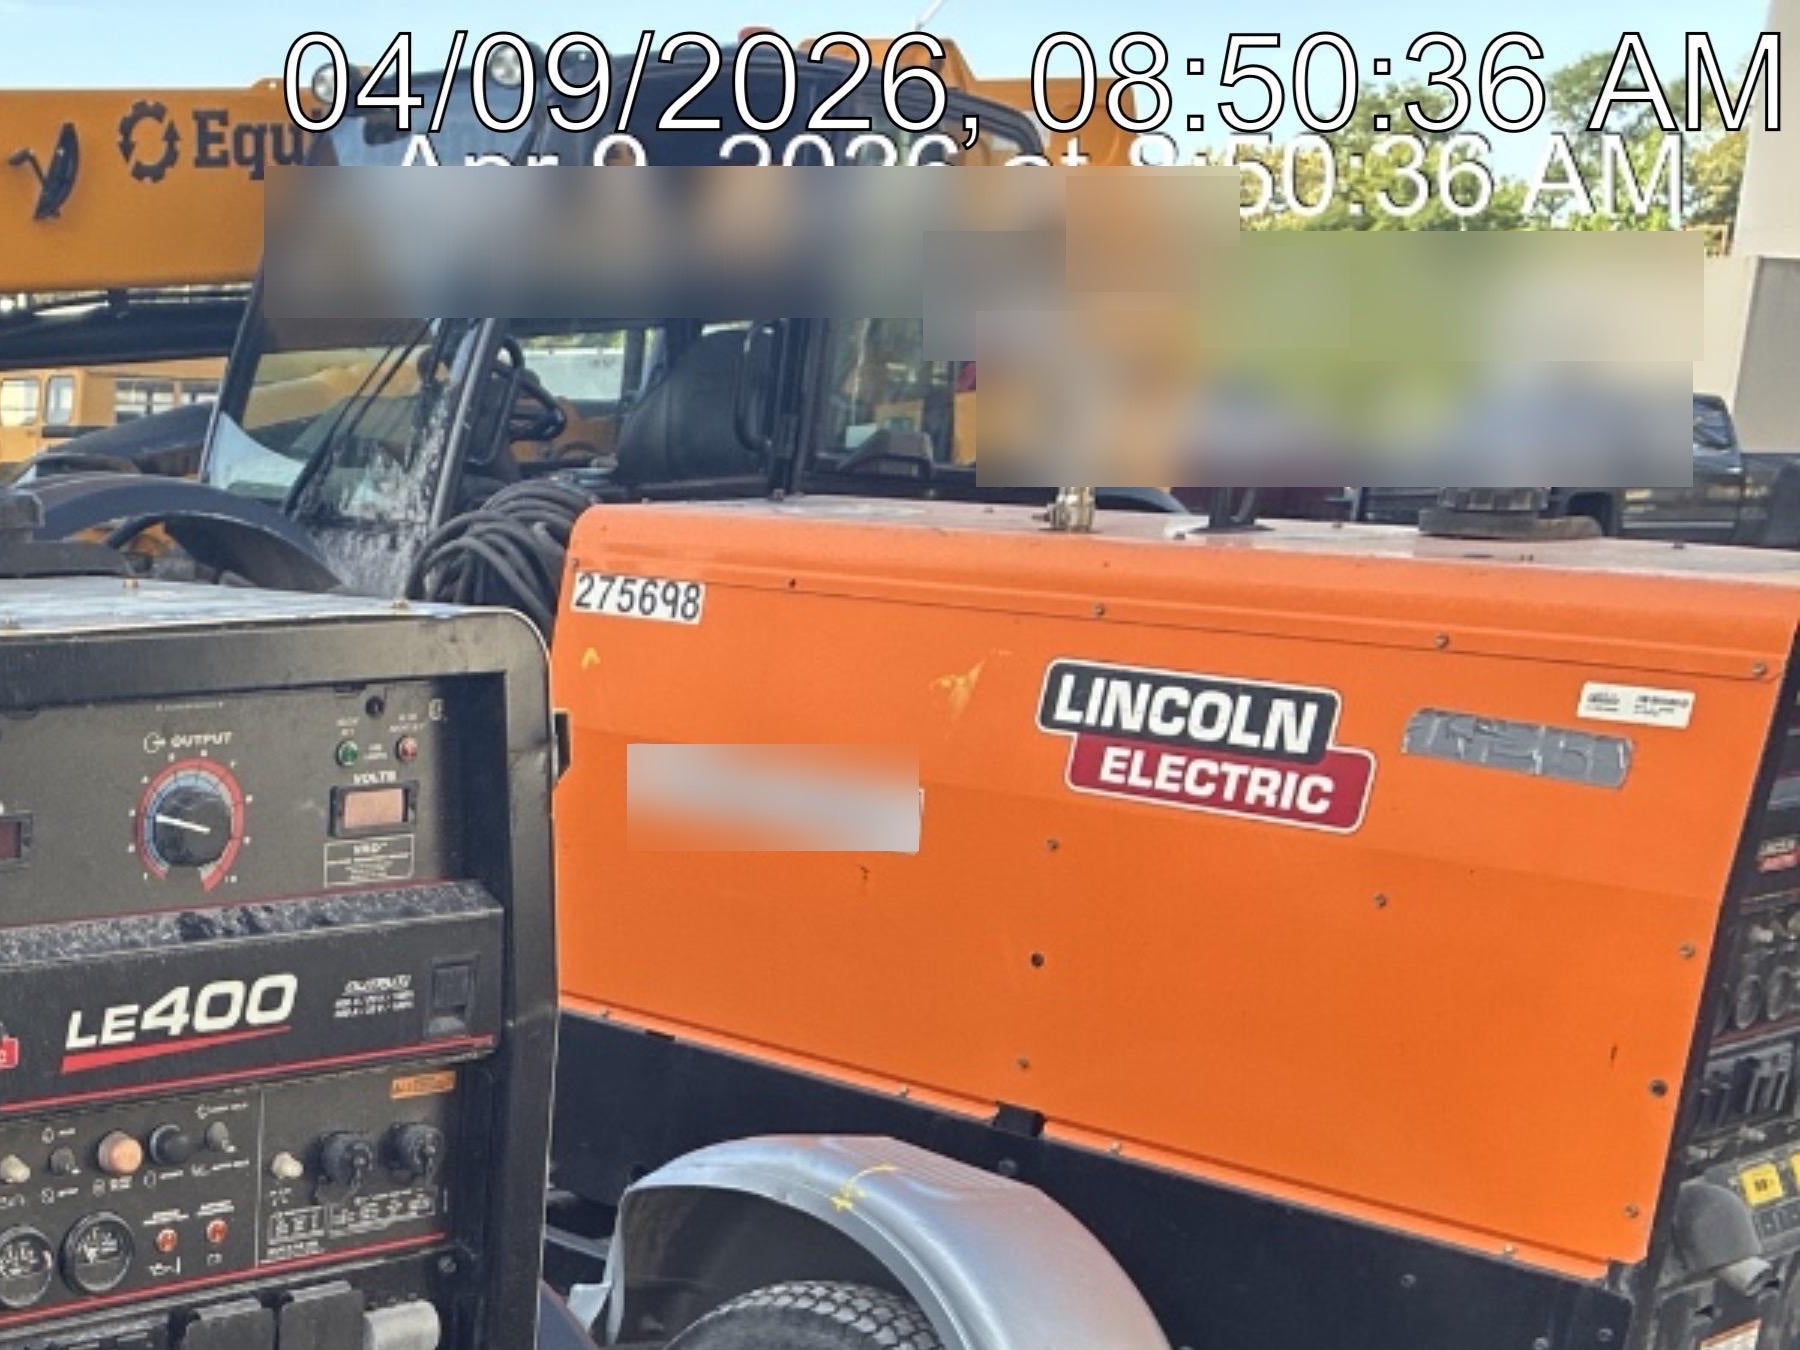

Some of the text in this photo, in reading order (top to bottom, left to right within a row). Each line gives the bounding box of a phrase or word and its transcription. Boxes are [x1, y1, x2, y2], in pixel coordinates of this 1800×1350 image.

[574, 571, 701, 622] 275698
[171, 731, 232, 748] OUTPUT
[1052, 673, 1319, 757] LINCOLN
[1098, 745, 1337, 817] ELECTRIC
[65, 974, 298, 1050] LE400
